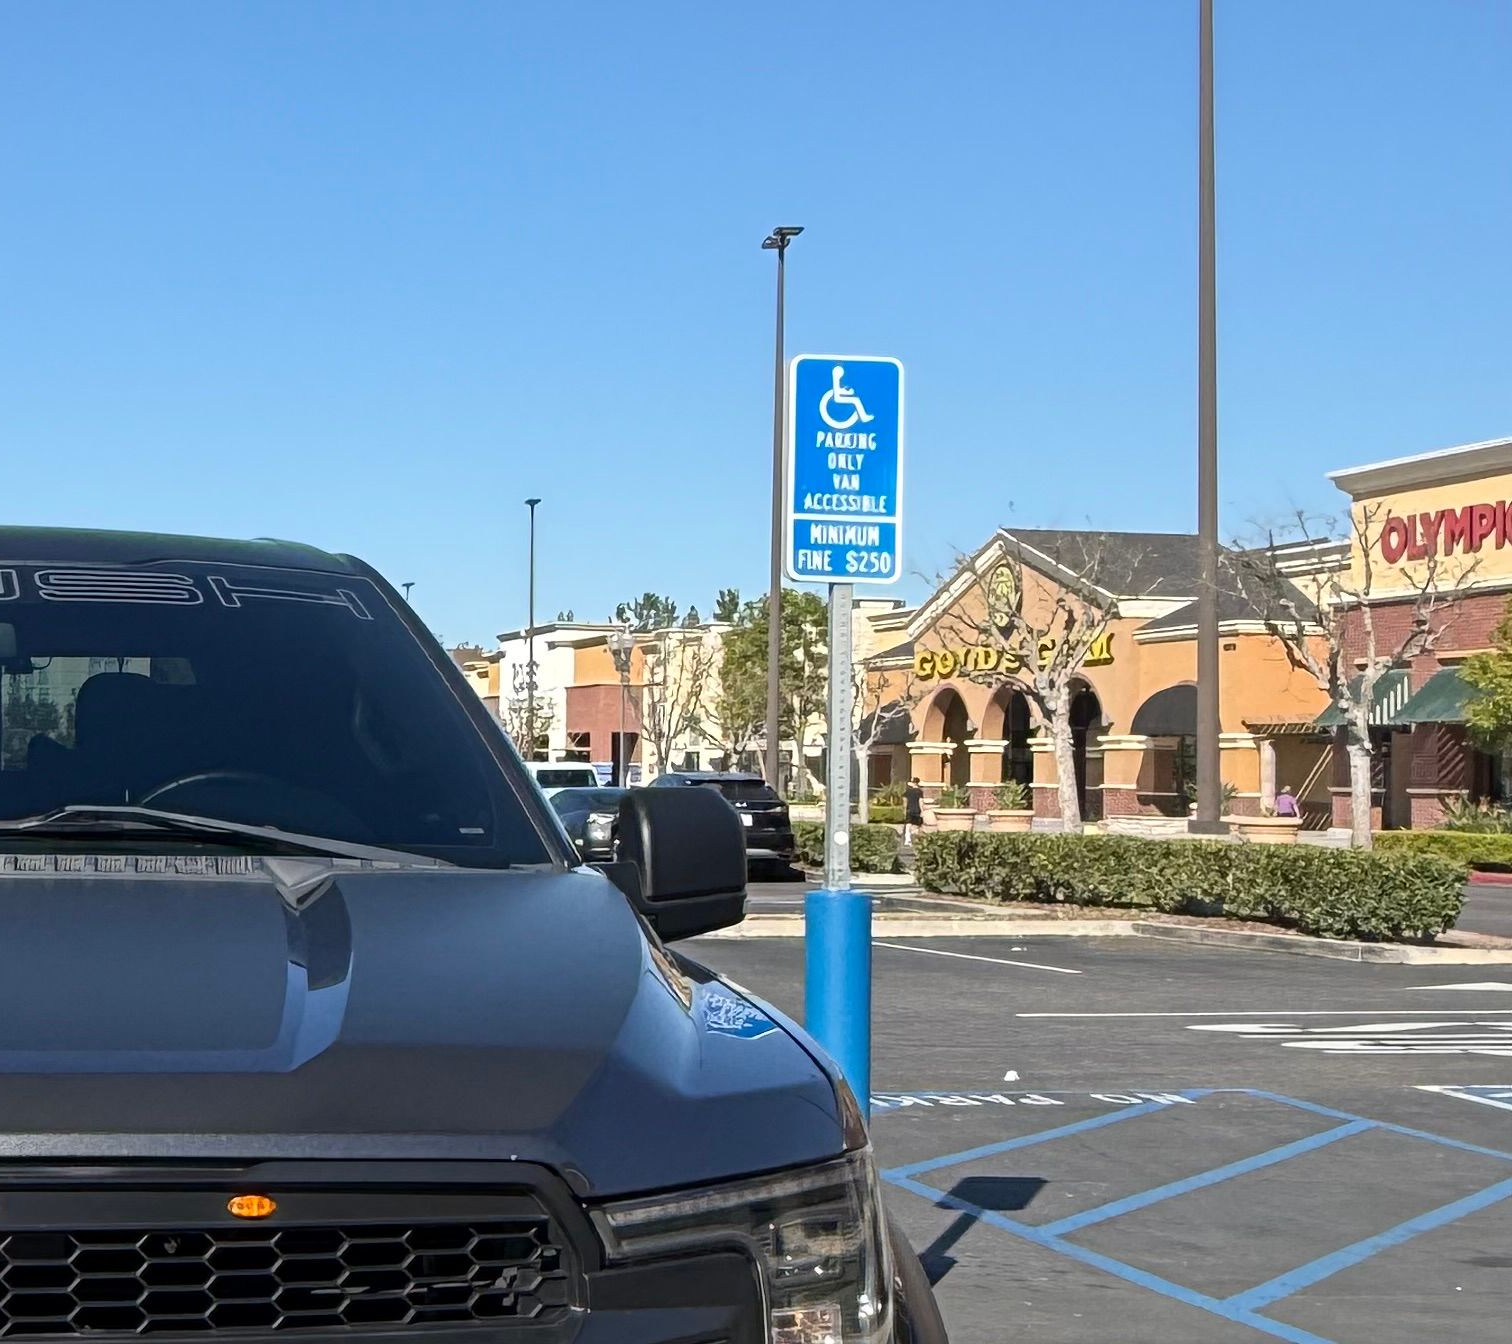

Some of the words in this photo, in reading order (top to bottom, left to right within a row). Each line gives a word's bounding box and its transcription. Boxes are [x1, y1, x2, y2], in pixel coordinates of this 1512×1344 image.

[816, 432, 877, 449] PARKING
[828, 453, 864, 470] ONLY
[832, 474, 861, 491] VAN
[804, 493, 886, 513] ACCESSIBLE
[810, 523, 879, 546] MINIMUM
[798, 549, 832, 571] FINE
[846, 550, 891, 574] $250
[870, 1093, 1065, 1107] PARKI
